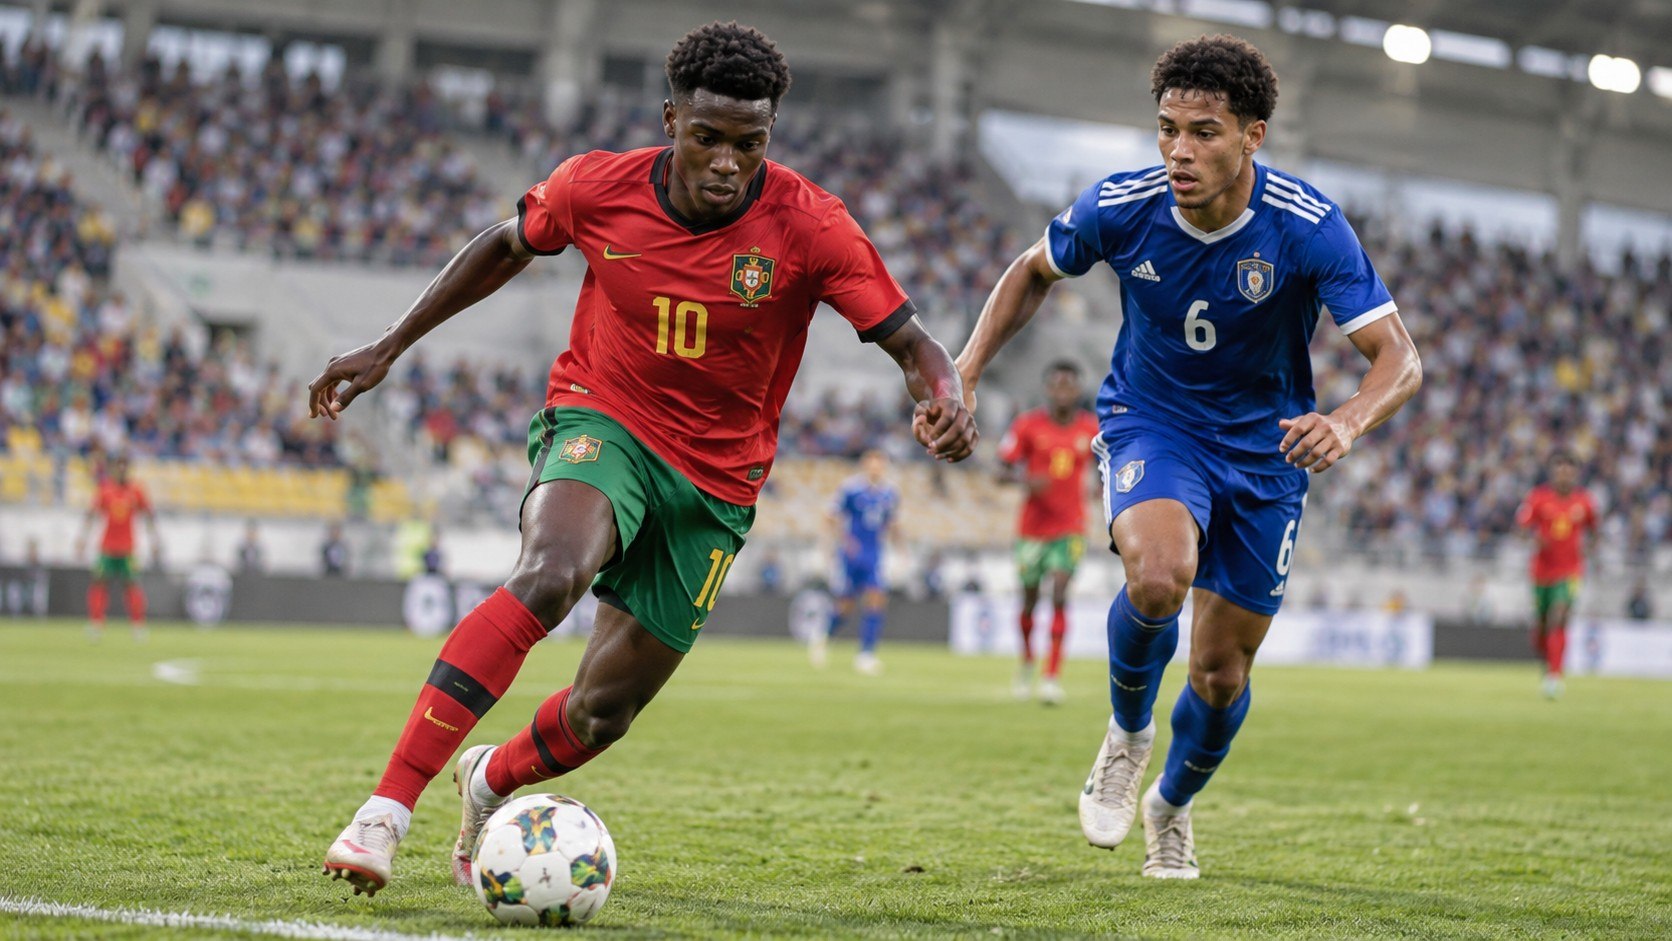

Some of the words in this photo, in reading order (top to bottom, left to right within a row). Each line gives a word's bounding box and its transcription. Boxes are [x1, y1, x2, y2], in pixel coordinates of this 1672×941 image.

[653, 296, 708, 359] 10
[1184, 300, 1217, 351] 6
[1276, 519, 1296, 576] 6
